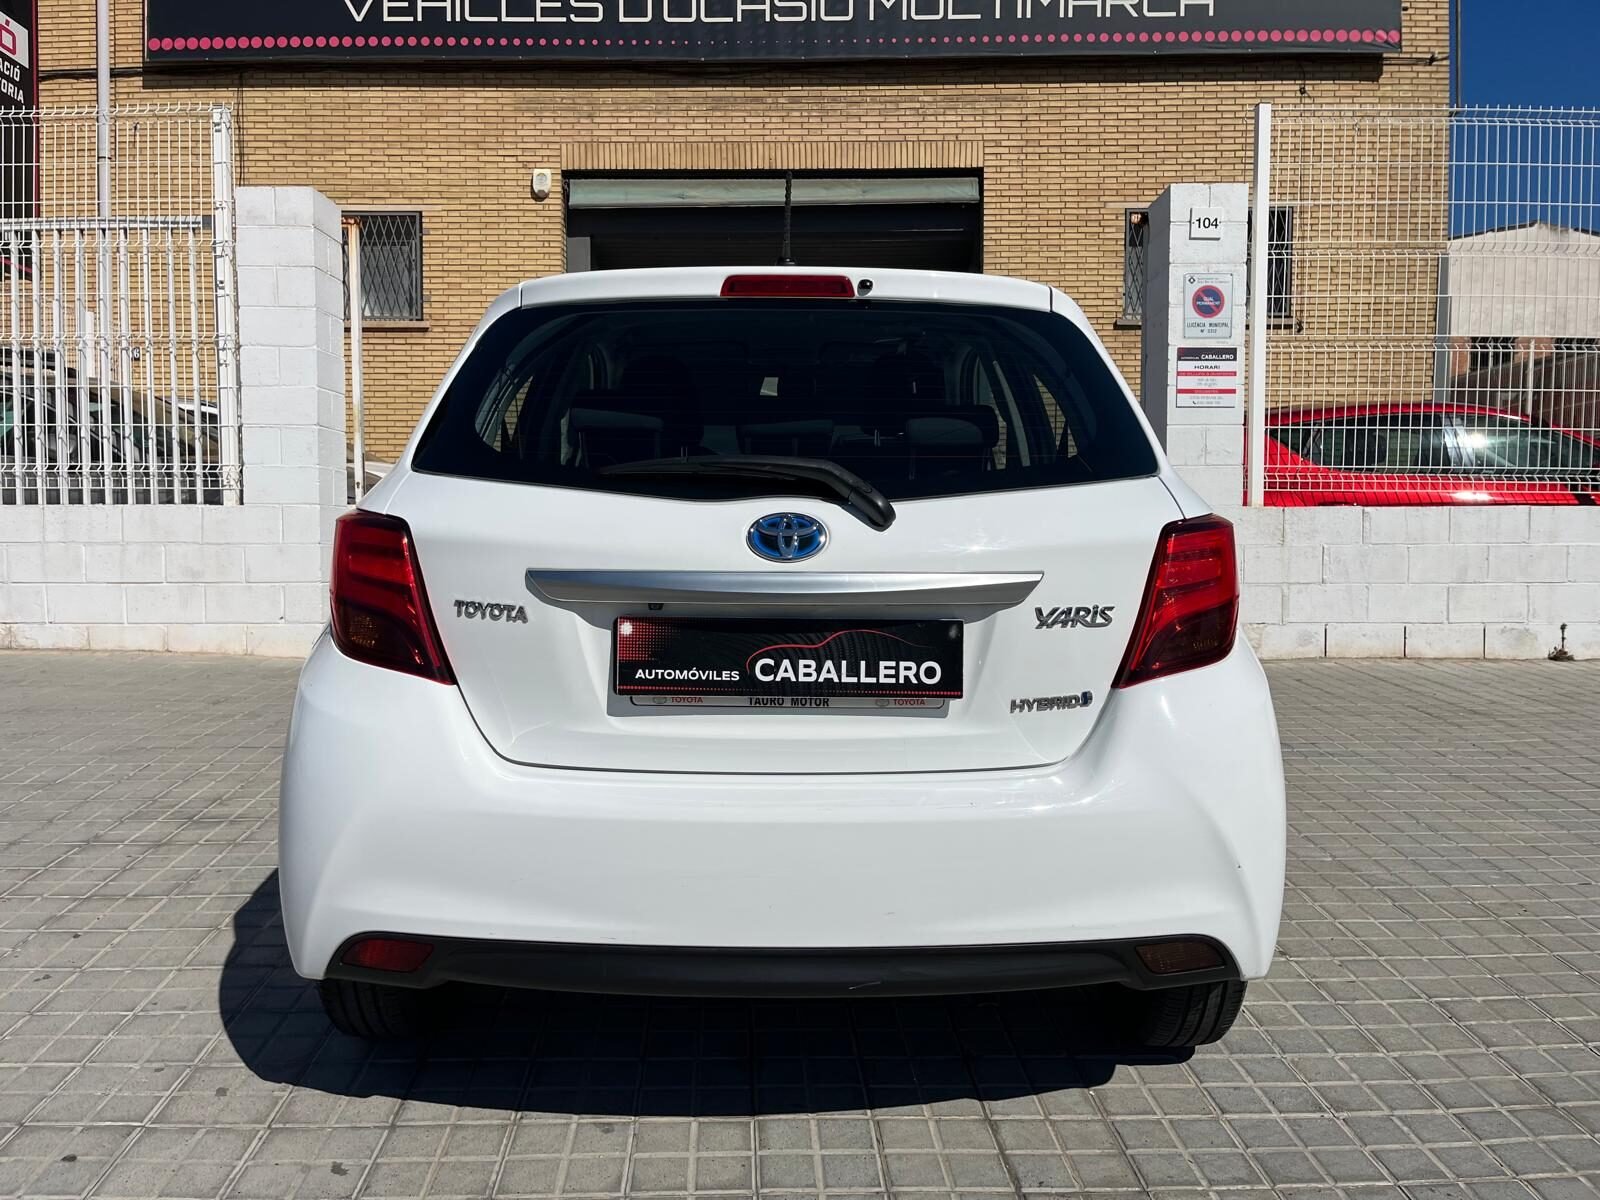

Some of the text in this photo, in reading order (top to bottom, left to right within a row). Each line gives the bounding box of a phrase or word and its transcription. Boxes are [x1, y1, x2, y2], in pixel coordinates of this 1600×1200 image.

[1195, 217, 1219, 229] 104
[453, 599, 529, 624] TOYOTA
[634, 657, 942, 685] AUTOMÓVILES CABALLERO
[671, 696, 704, 704] TOYOTA
[748, 697, 785, 706] TAURO
[790, 697, 830, 707] MOTOR
[1009, 694, 1081, 714] HYBRID
